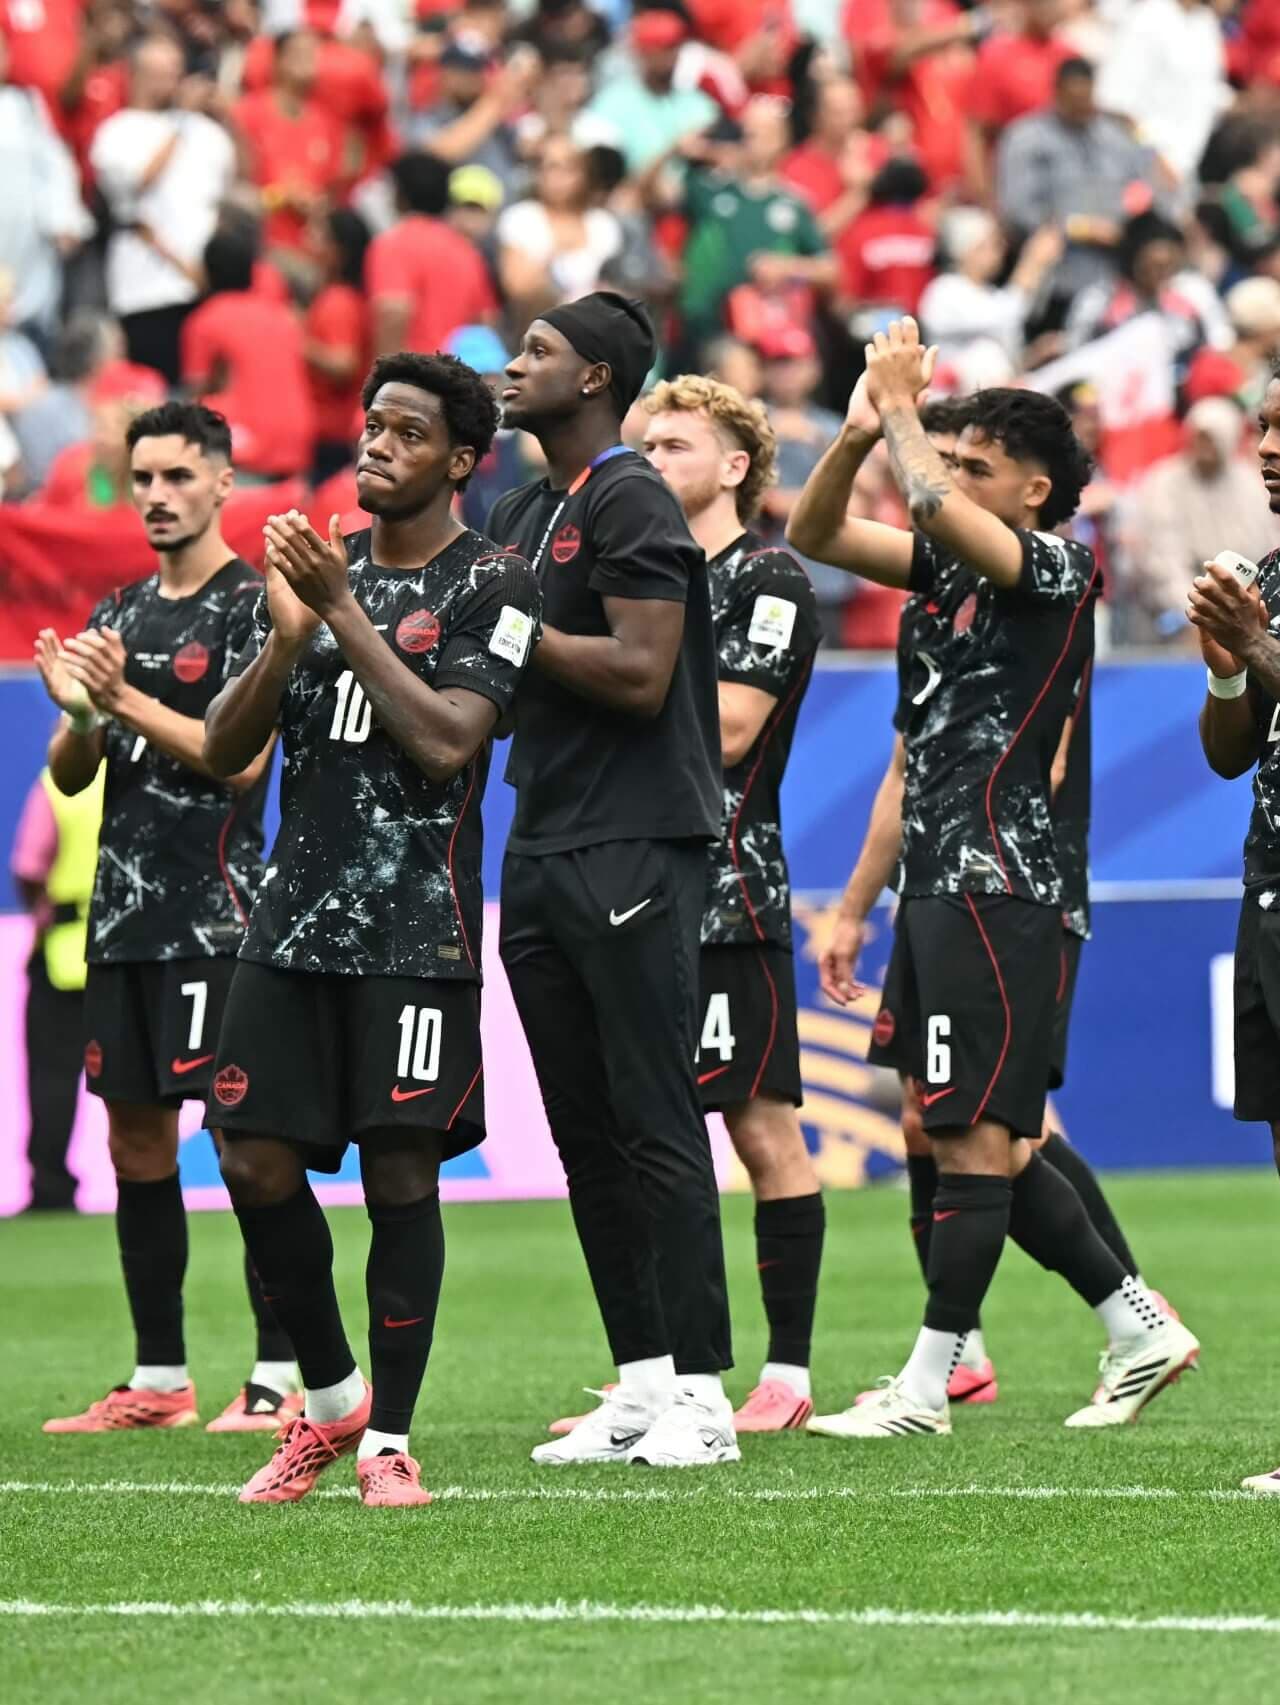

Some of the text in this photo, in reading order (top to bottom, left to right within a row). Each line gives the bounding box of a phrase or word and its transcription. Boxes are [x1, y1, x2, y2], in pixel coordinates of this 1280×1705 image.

[329, 670, 373, 743] 10
[181, 981, 208, 1050] 7
[397, 1004, 443, 1081] 10
[693, 992, 736, 1064] 4
[926, 1014, 951, 1084] 6
[216, 1080, 247, 1089] CANADA
